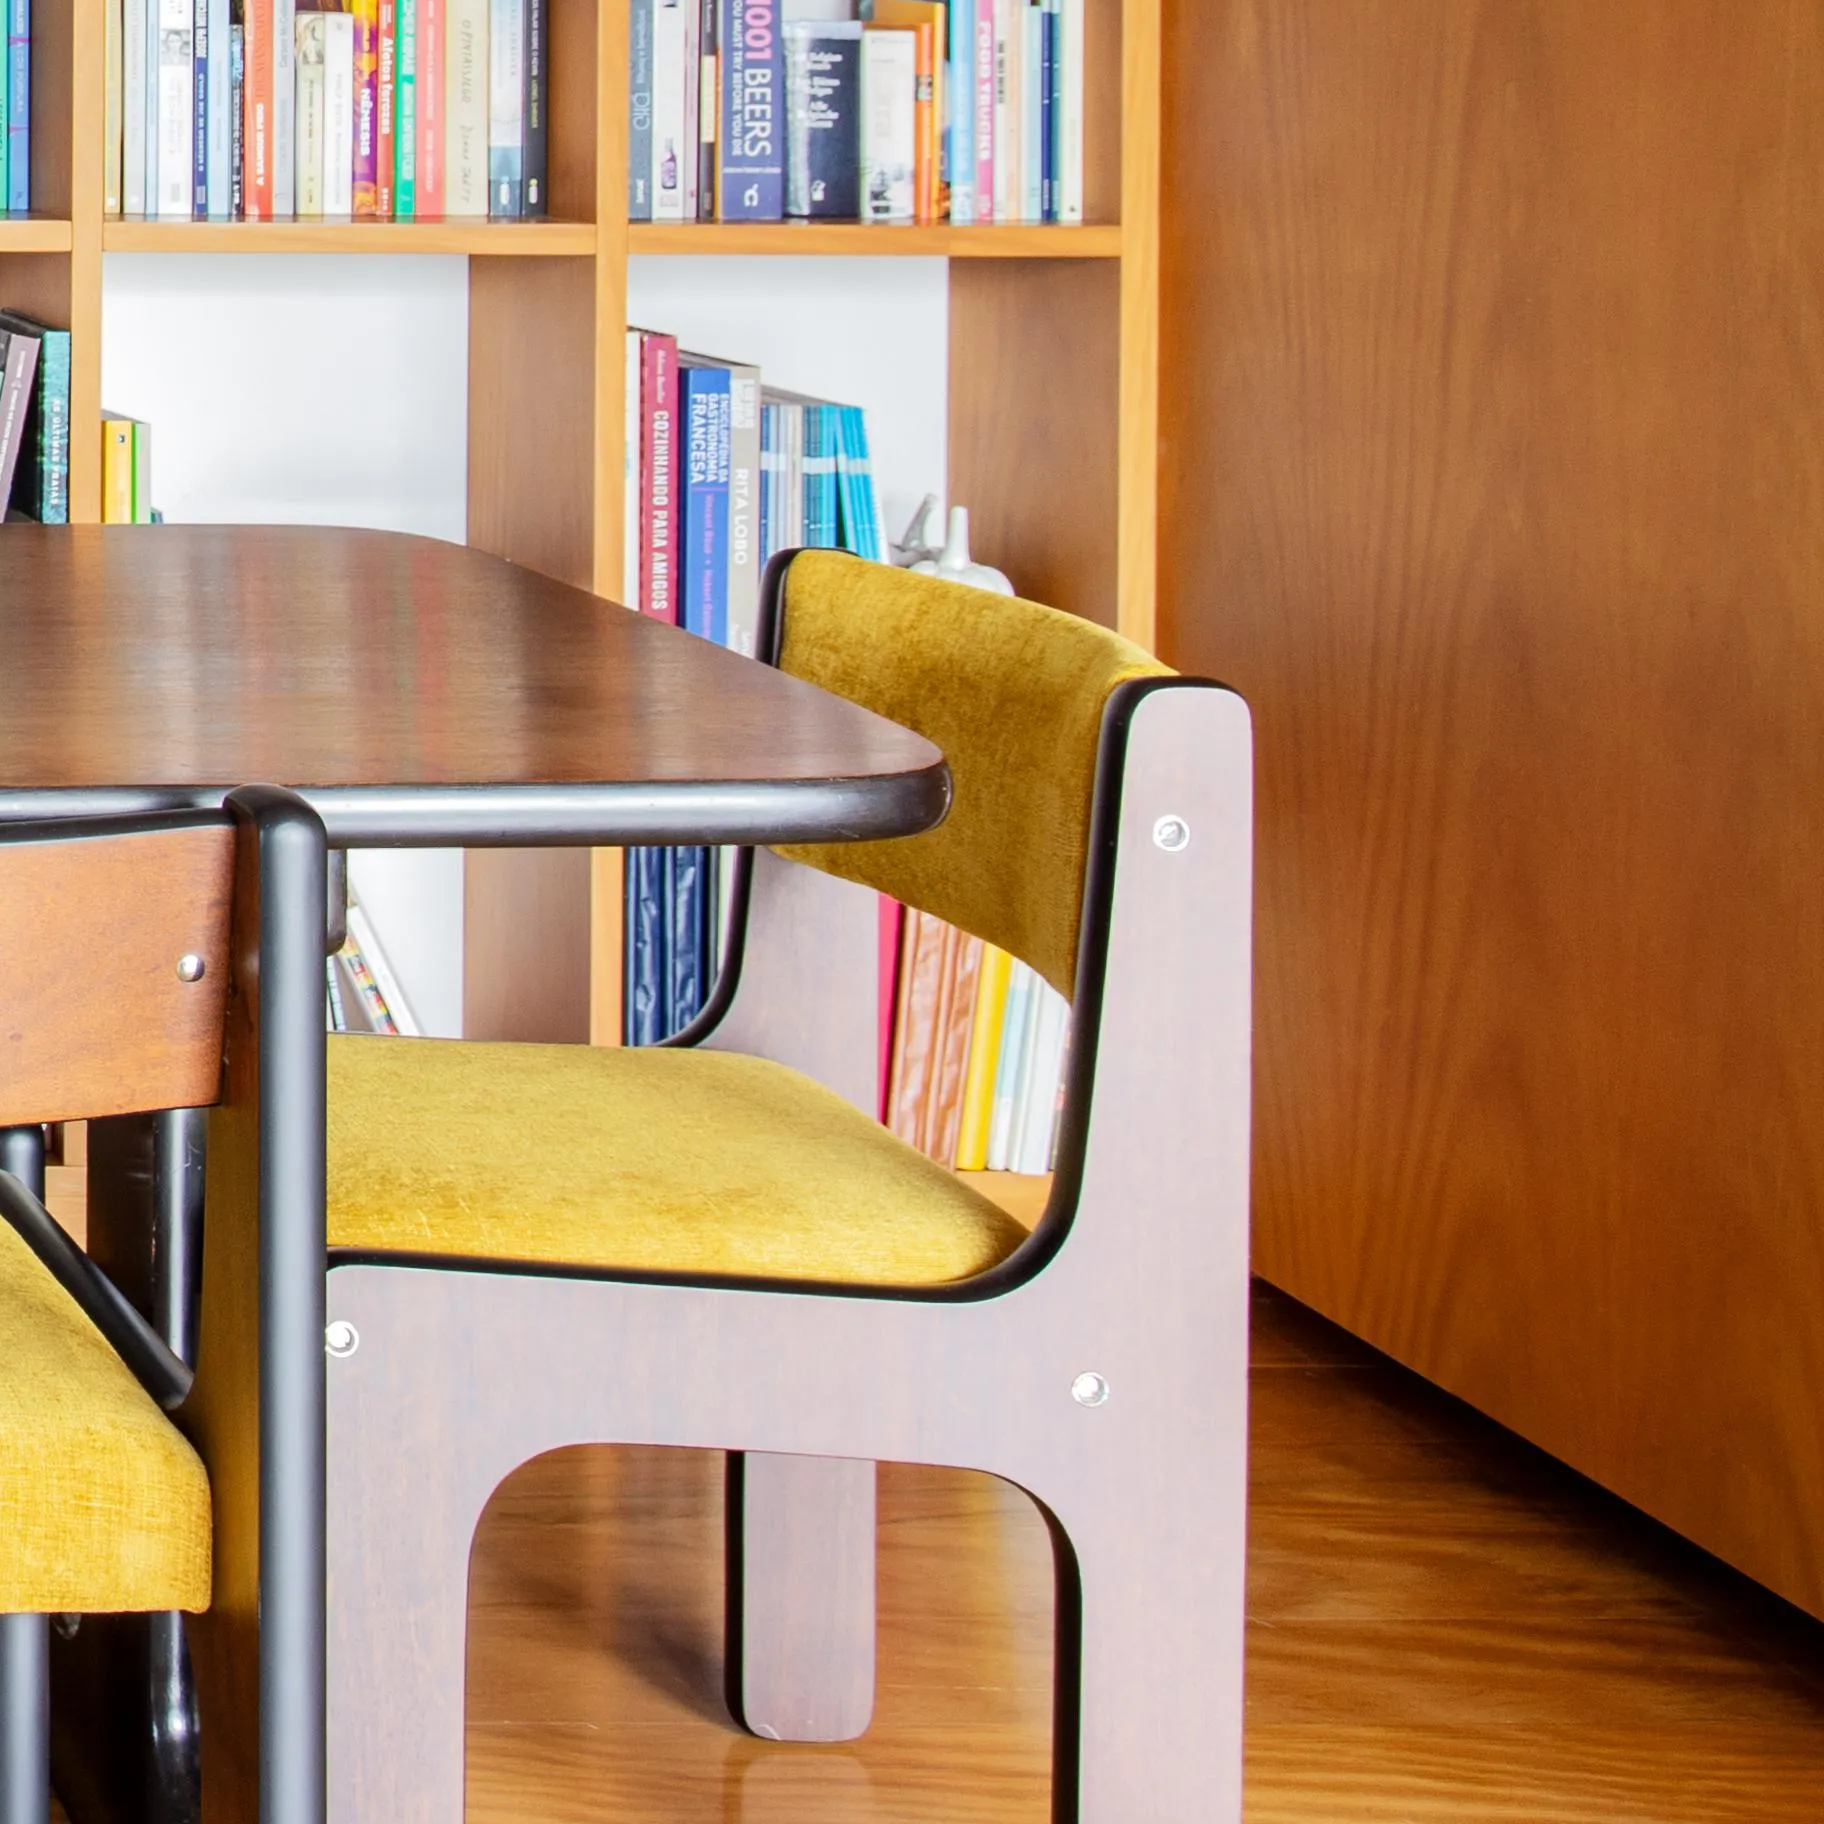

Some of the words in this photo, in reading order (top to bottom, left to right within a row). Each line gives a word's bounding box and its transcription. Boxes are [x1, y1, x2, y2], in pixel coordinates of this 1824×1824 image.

[461, 19, 473, 27] O
[731, 18, 743, 48] MUST
[16, 49, 26, 68] COR
[381, 36, 394, 80] Afetos
[461, 29, 473, 104] PINTASSILGO
[731, 50, 743, 69] TRY
[979, 21, 992, 78] FOOD
[381, 82, 394, 134] ferozes
[731, 71, 743, 110] BEFORE
[745, 68, 772, 156] BEERS
[255, 103, 264, 129] FRIO
[360, 88, 374, 156] NÊMESIS
[731, 112, 743, 136] YOU
[979, 83, 992, 160] TRUCKS
[255, 131, 264, 175] SANGUE
[731, 138, 743, 156] DIE
[255, 177, 264, 186] A
[690, 393, 706, 484] FRANCESA
[707, 393, 719, 484] GASTRONOMIA
[718, 393, 728, 468] ENCICLOPÉDIA
[651, 411, 670, 506] COZINHANDO
[718, 470, 728, 484] DA
[734, 468, 749, 512] RITA
[651, 509, 669, 551] PARA
[734, 515, 749, 565] LOBO
[651, 553, 669, 611] AMIGOS
